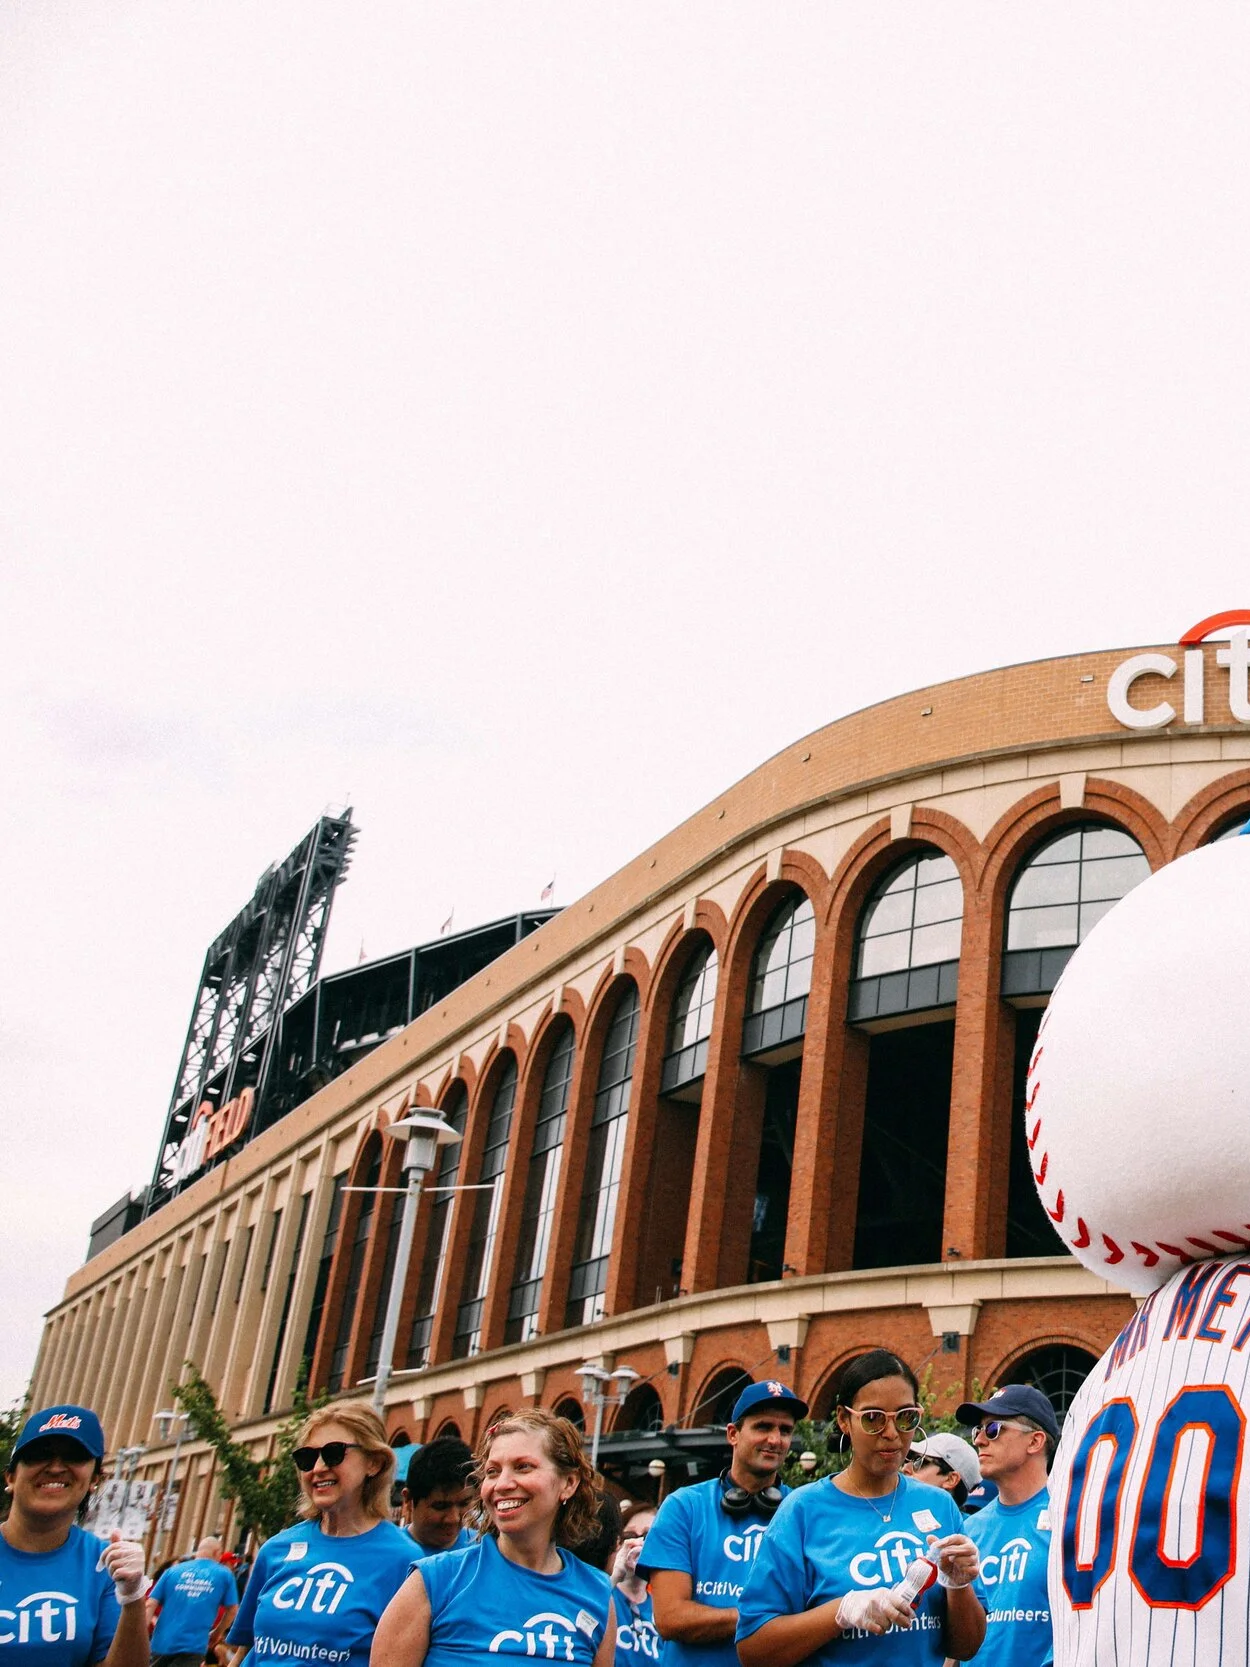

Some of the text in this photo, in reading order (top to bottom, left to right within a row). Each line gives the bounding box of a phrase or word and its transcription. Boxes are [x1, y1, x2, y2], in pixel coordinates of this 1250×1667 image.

[39, 1413, 82, 1433] Mets
[1061, 1384, 1248, 1611] 00
[979, 1543, 1030, 1586] citi
[272, 1567, 352, 1615] citi
[616, 1623, 660, 1660] citi
